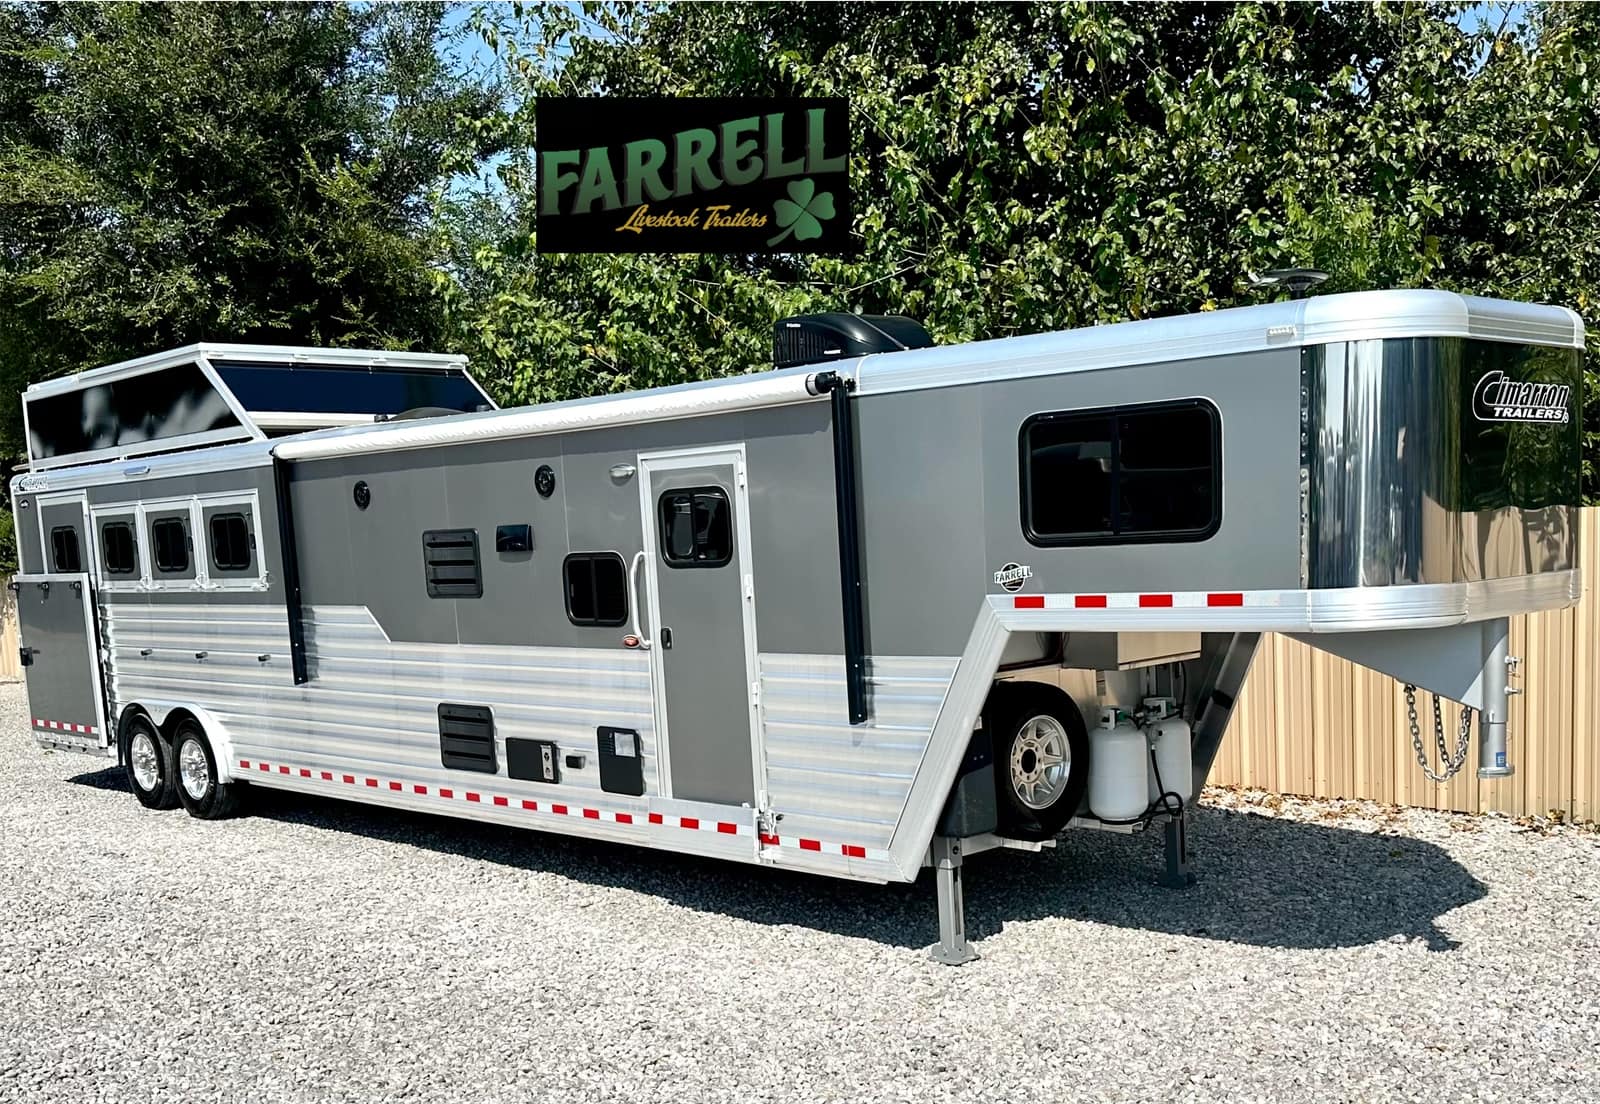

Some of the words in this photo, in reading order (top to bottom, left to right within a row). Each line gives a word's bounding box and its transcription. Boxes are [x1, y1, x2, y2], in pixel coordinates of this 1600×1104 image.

[1472, 370, 1570, 421] Cimarron
[1493, 407, 1563, 419] TRAILERS
[994, 566, 1032, 583] FARRELL
